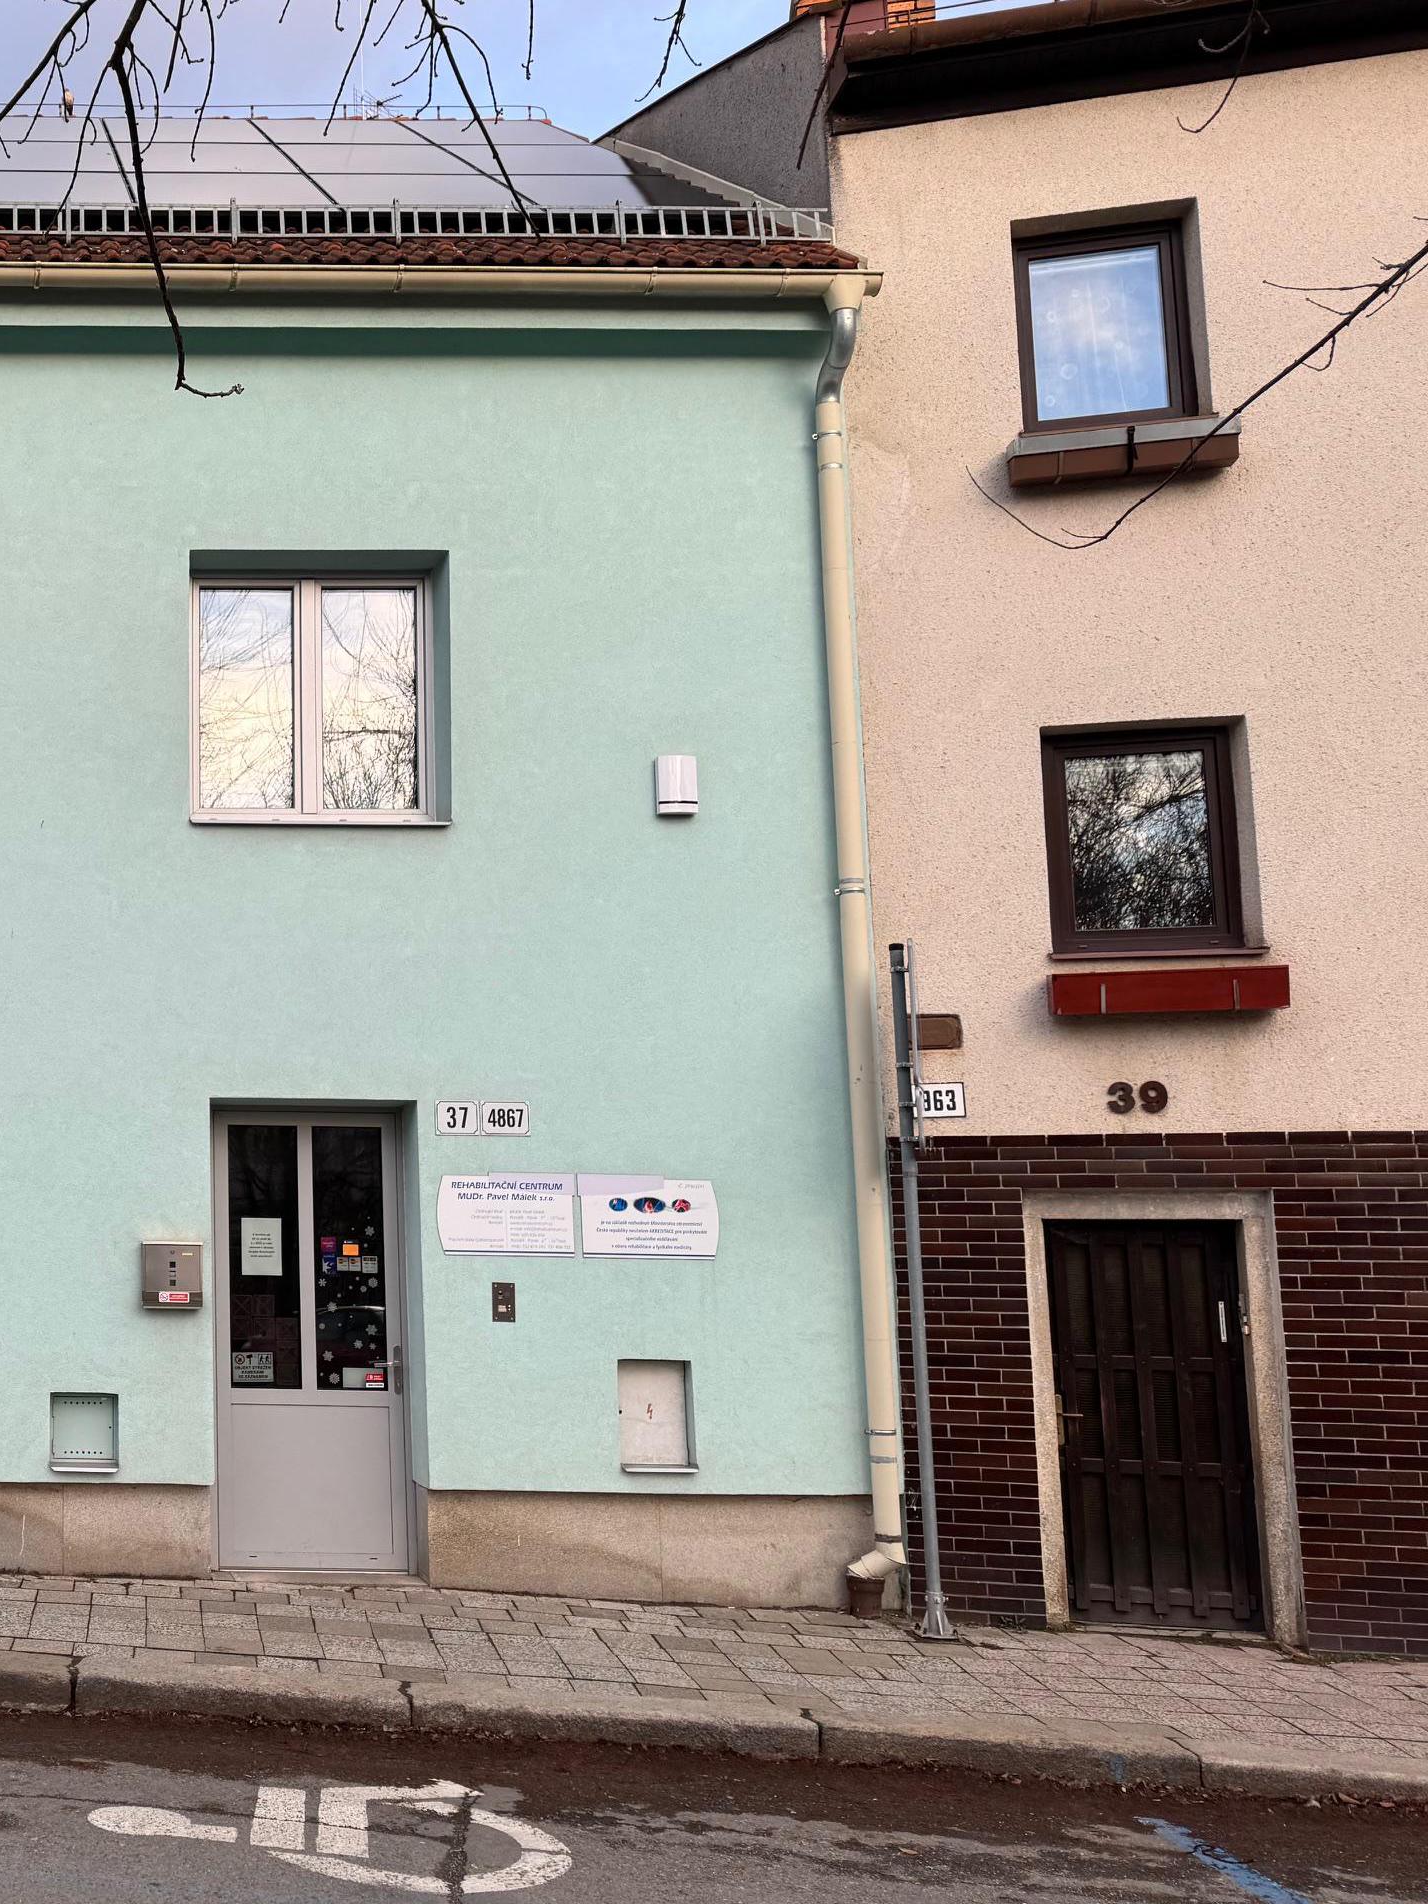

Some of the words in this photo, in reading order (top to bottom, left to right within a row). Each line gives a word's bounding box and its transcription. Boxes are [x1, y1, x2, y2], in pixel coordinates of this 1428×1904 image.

[1107, 1081, 1168, 1115] 39
[446, 1106, 469, 1128] 37
[487, 1108, 524, 1128] 4867
[451, 1180, 517, 1190] REHABILITAČNÍ
[519, 1182, 563, 1191] CENTRUM
[457, 1192, 484, 1200] MUDr.
[487, 1192, 509, 1201] Pavel
